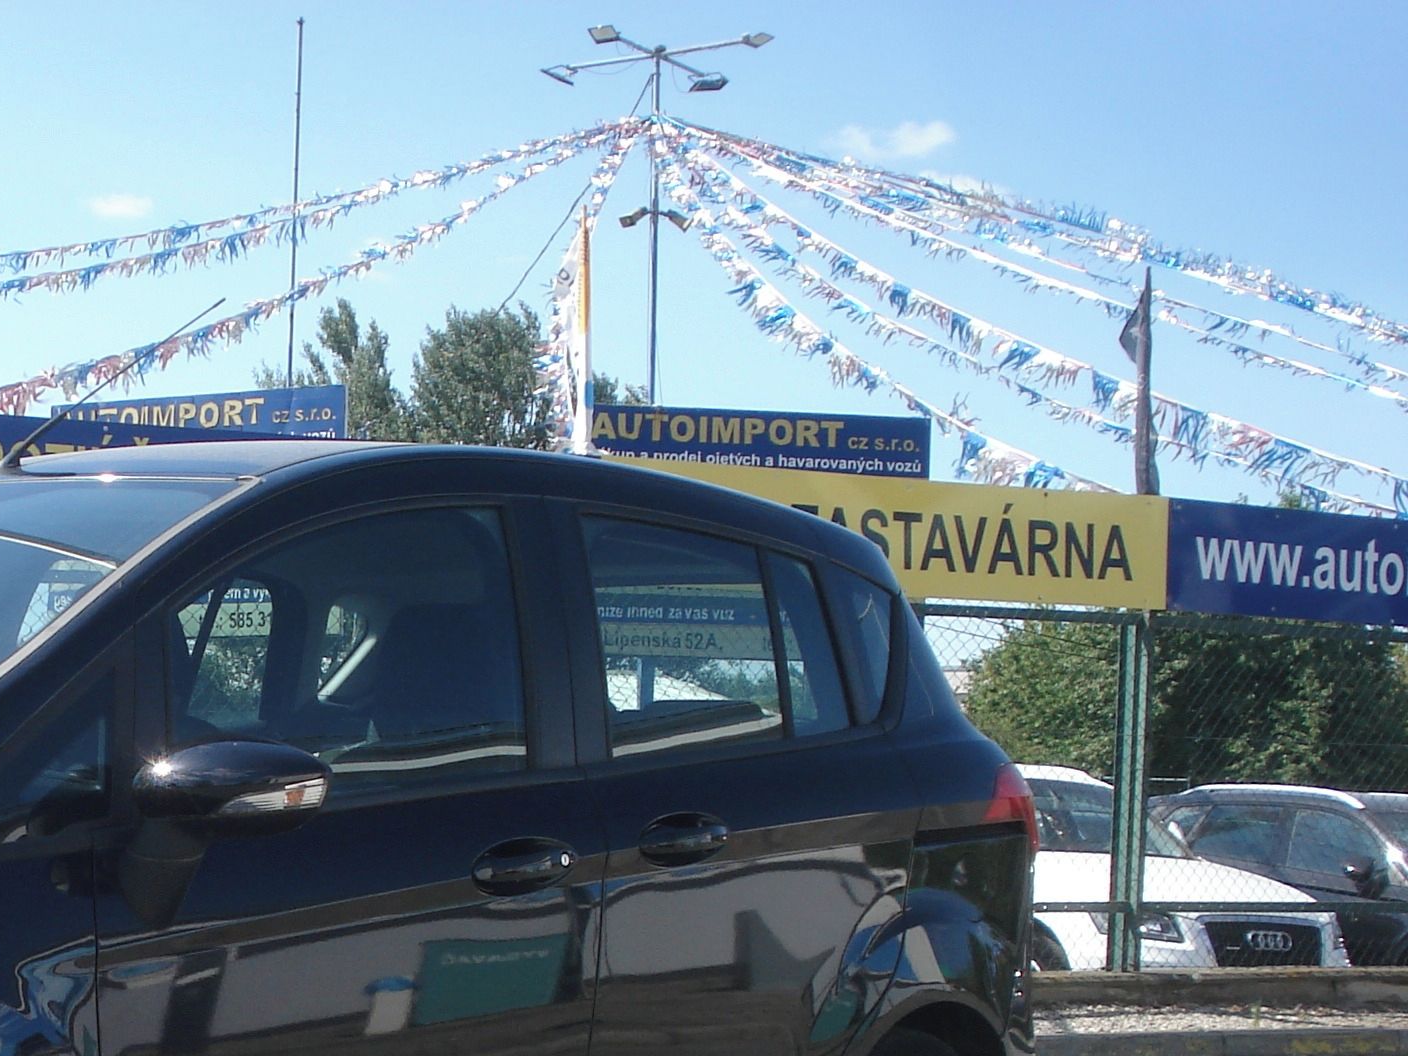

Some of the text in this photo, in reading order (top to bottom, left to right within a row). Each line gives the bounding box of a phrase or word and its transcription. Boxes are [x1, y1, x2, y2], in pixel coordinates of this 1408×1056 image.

[272, 410, 290, 423] cz
[295, 407, 336, 421] s.r.o.
[592, 412, 920, 452] AUTOIMPORT cz s.r.o.
[765, 455, 774, 466] a
[778, 454, 883, 473] havarovaných
[791, 494, 1133, 581] STAVÁRNA
[1195, 536, 1408, 596] www.auto
[229, 612, 253, 629] 585
